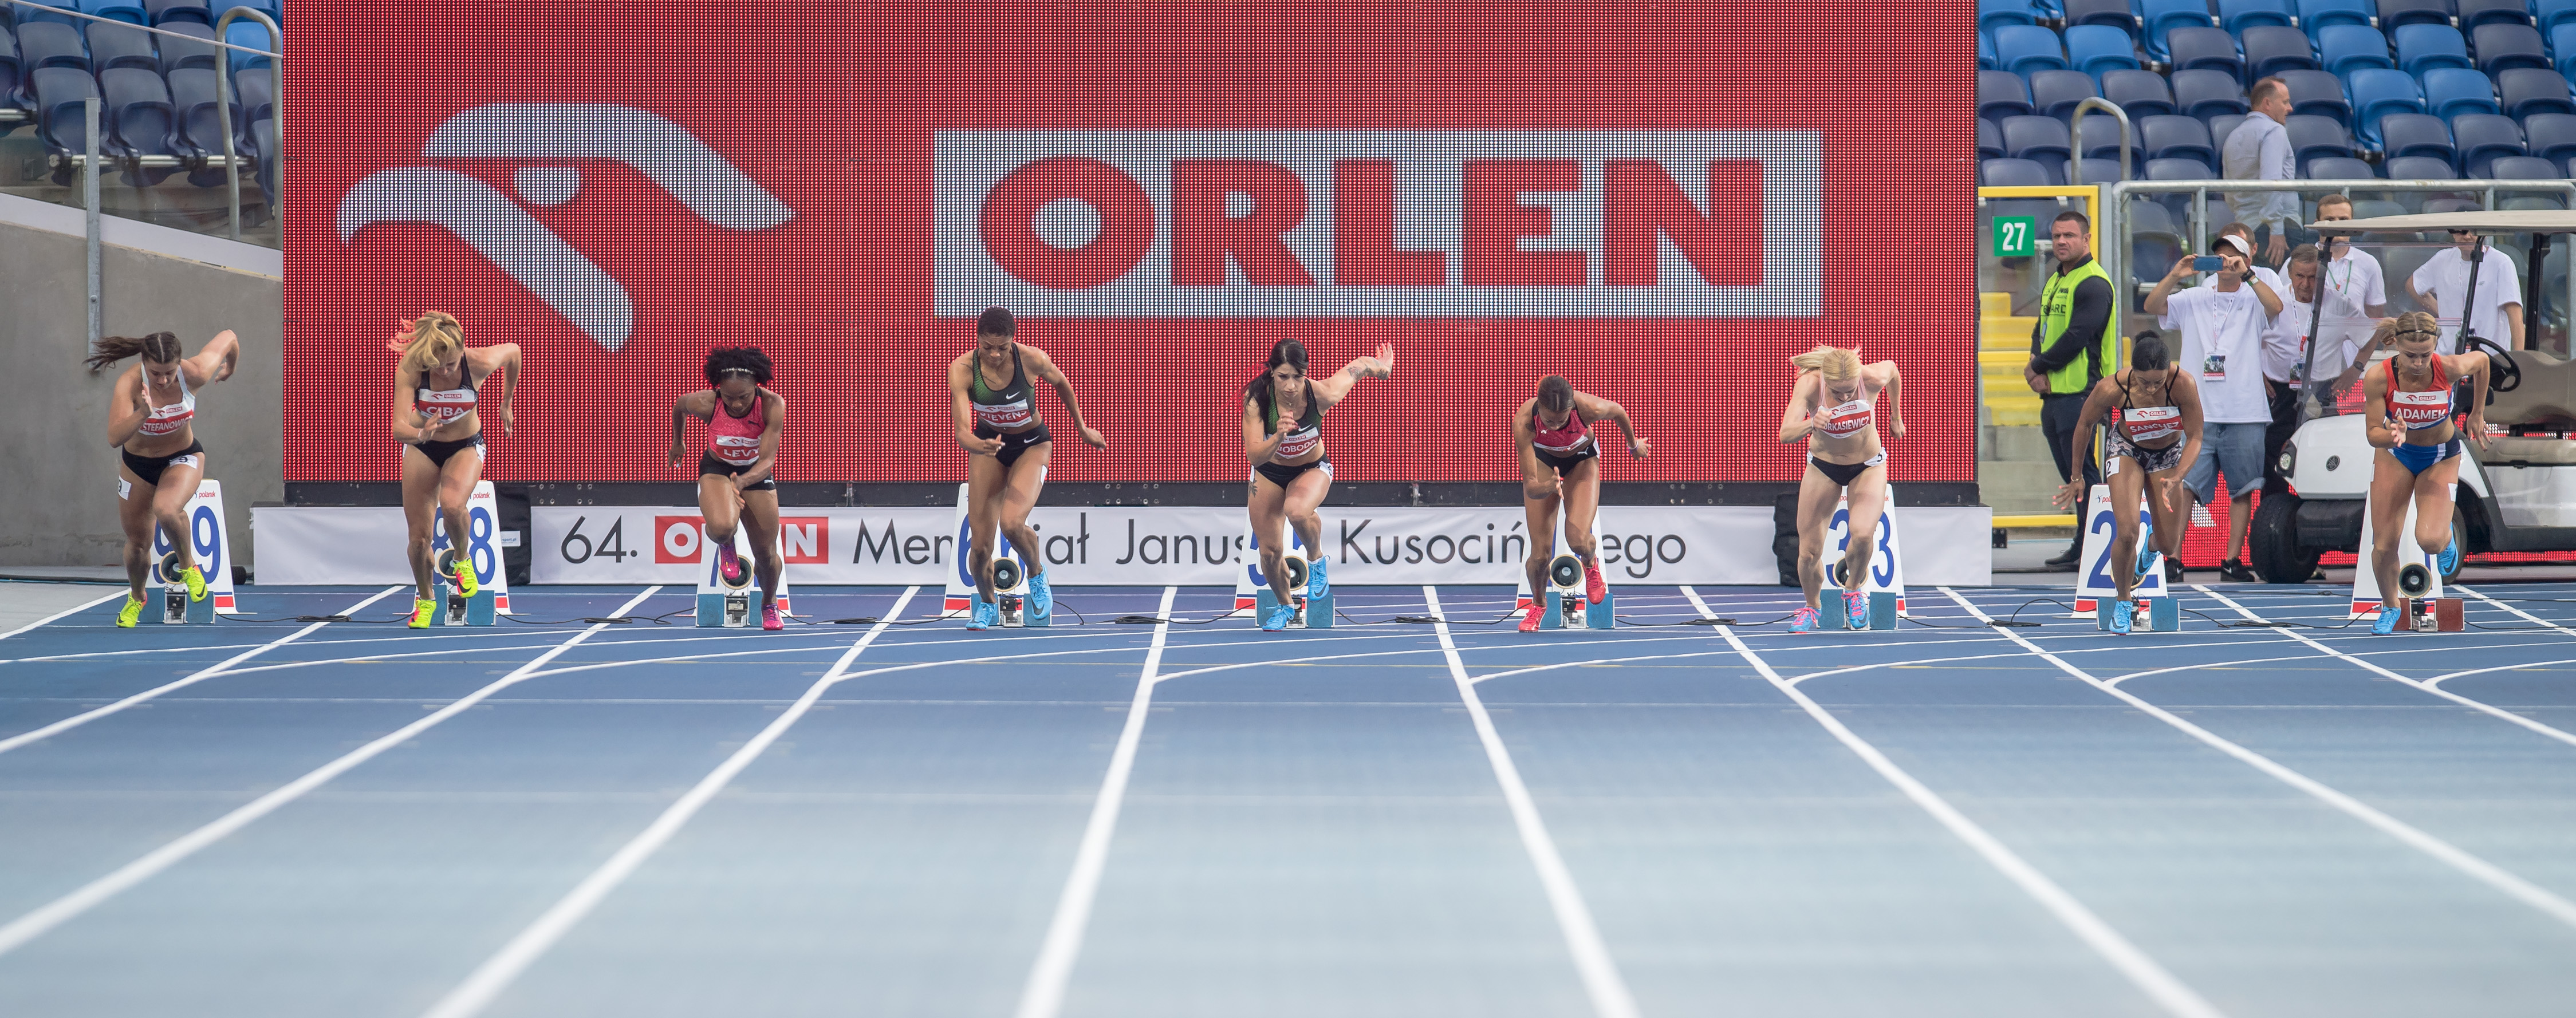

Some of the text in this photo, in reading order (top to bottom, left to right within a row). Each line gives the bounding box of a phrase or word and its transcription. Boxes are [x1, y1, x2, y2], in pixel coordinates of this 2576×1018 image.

[979, 155, 1764, 291] ORLEN
[2002, 222, 2026, 251] 27
[426, 407, 464, 416] CIBA
[2394, 407, 2446, 420] ADAMEK
[1825, 416, 1869, 431] RKASIEWICZ
[2129, 421, 2179, 432] SANCHEZ
[724, 448, 759, 457] LEVY
[1278, 439, 1317, 453] OBODA
[2107, 461, 2112, 475] 2
[199, 491, 216, 499] polanik
[473, 492, 490, 500] polanik
[561, 514, 637, 564] 64.
